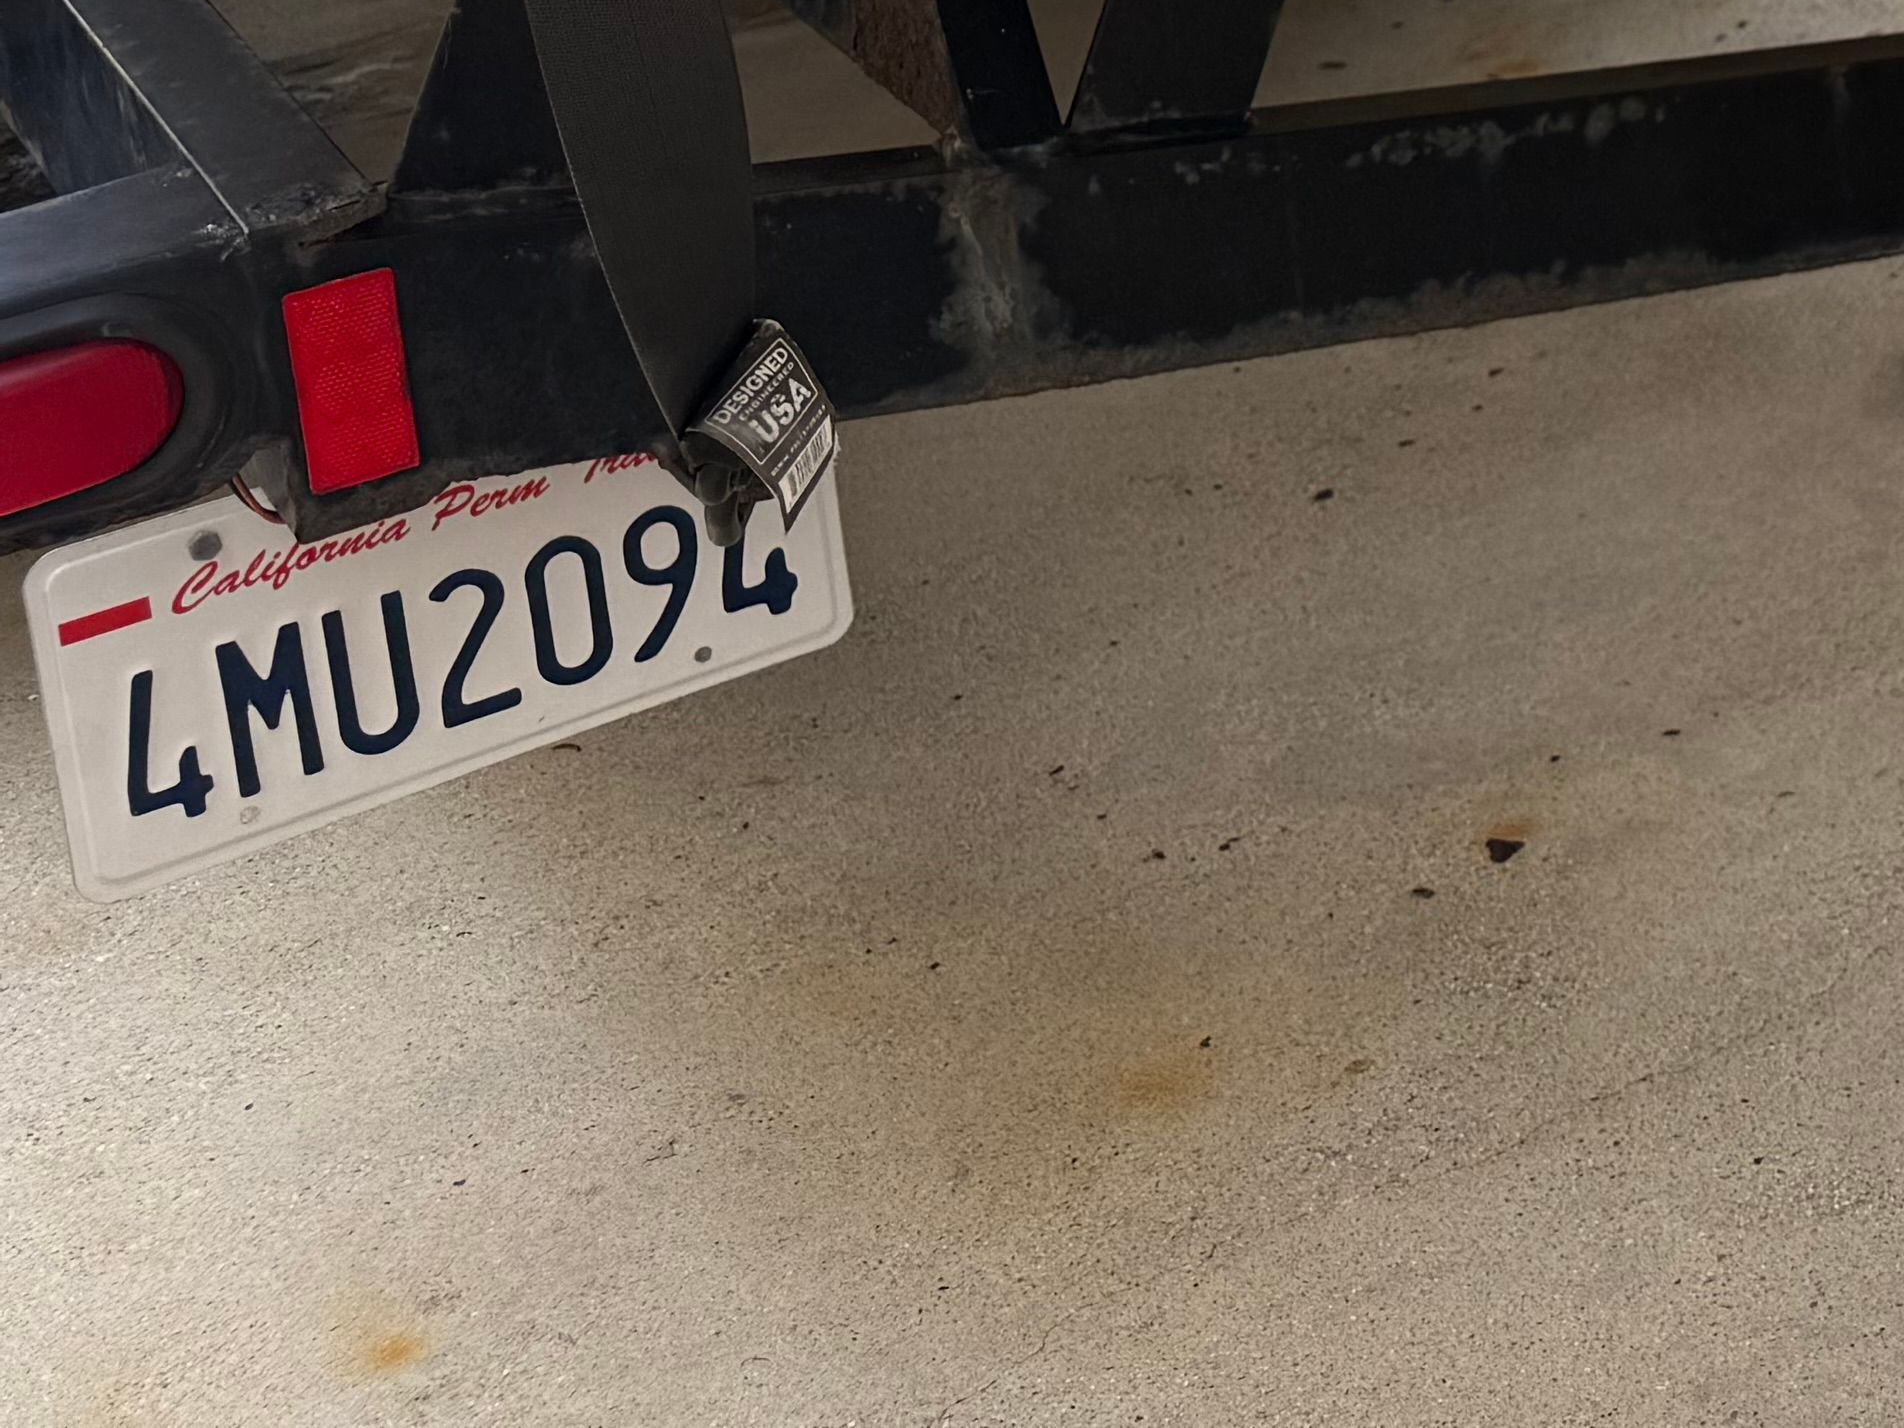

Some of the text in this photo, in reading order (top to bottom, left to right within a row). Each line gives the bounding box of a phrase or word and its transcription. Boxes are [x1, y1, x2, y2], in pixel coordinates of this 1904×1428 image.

[711, 347, 789, 425] DESIGNED
[748, 377, 812, 443] USA
[170, 474, 551, 615] California Perm
[126, 504, 799, 818] 4MU2094
